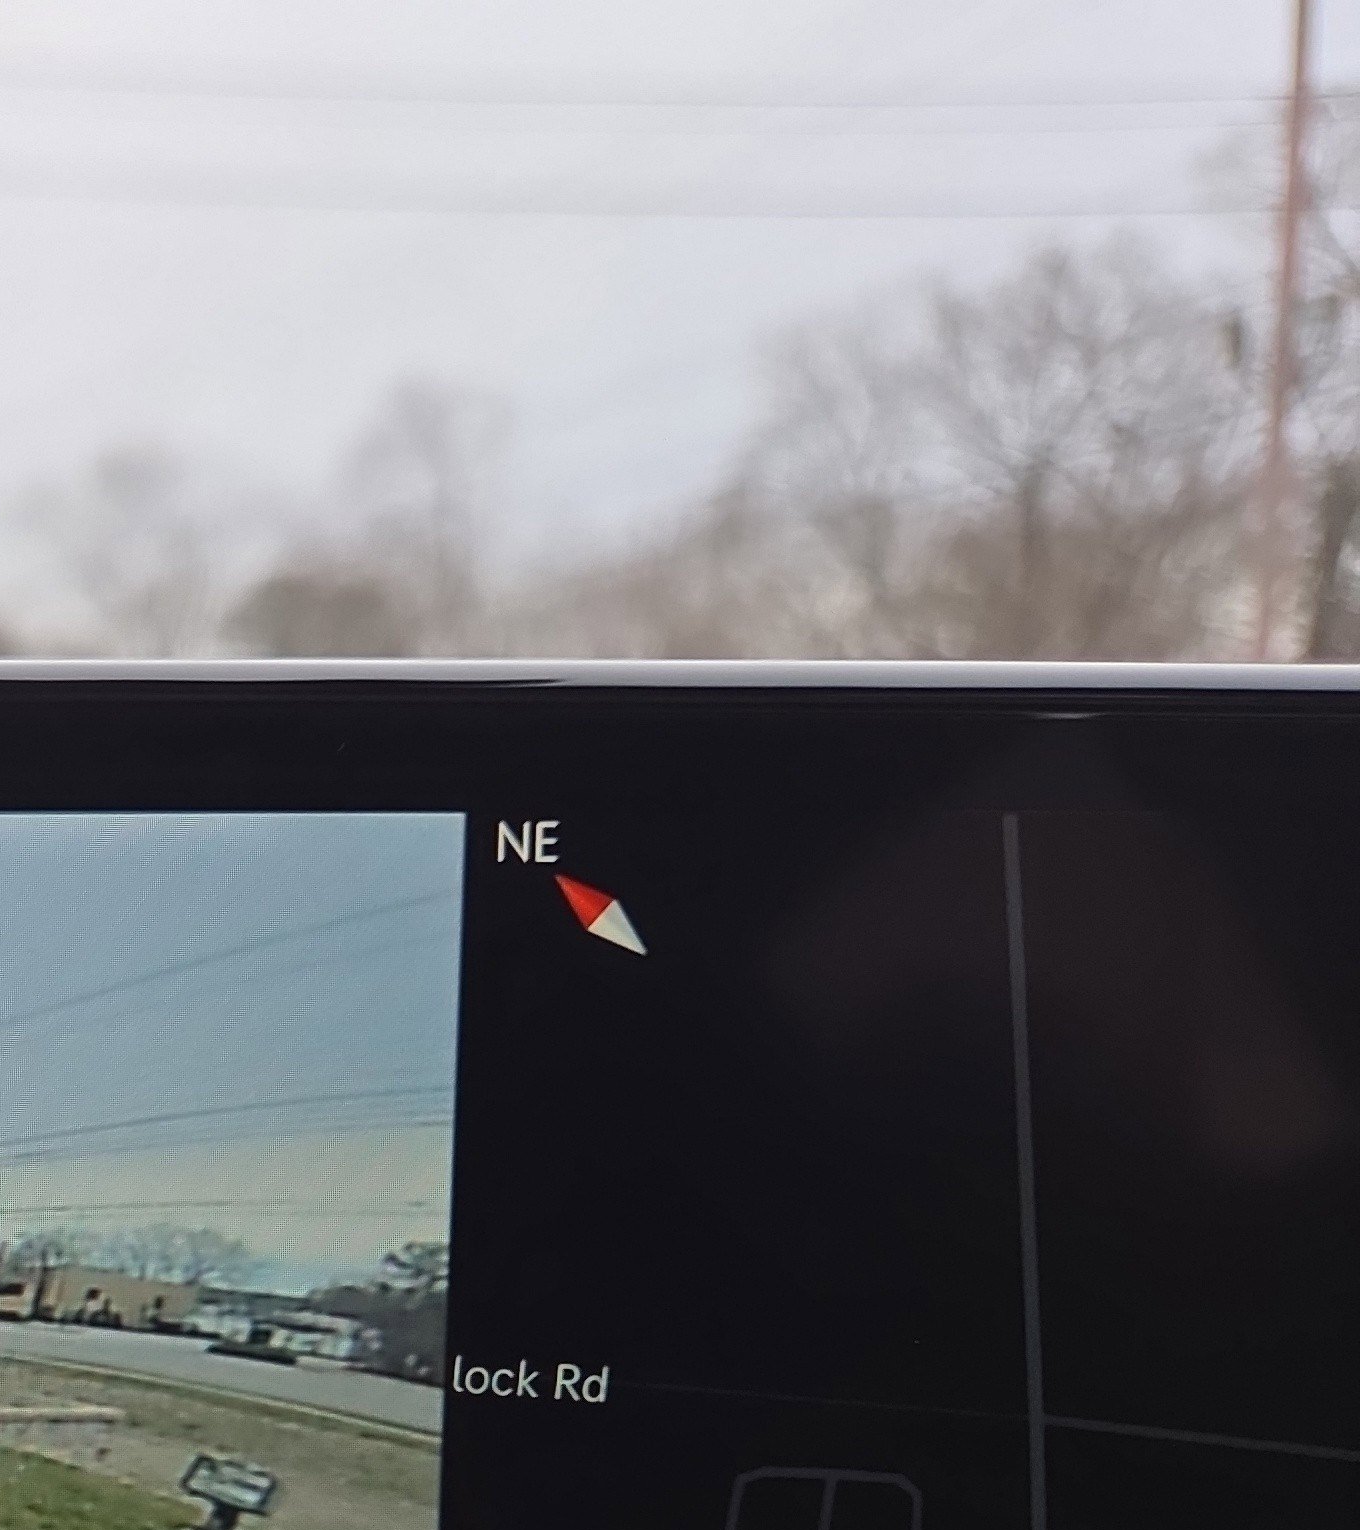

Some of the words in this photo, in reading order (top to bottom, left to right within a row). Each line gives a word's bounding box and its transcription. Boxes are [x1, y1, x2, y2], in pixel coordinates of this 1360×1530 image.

[496, 820, 560, 863] NE
[452, 1354, 540, 1398] lock
[553, 1363, 609, 1403] Rd
